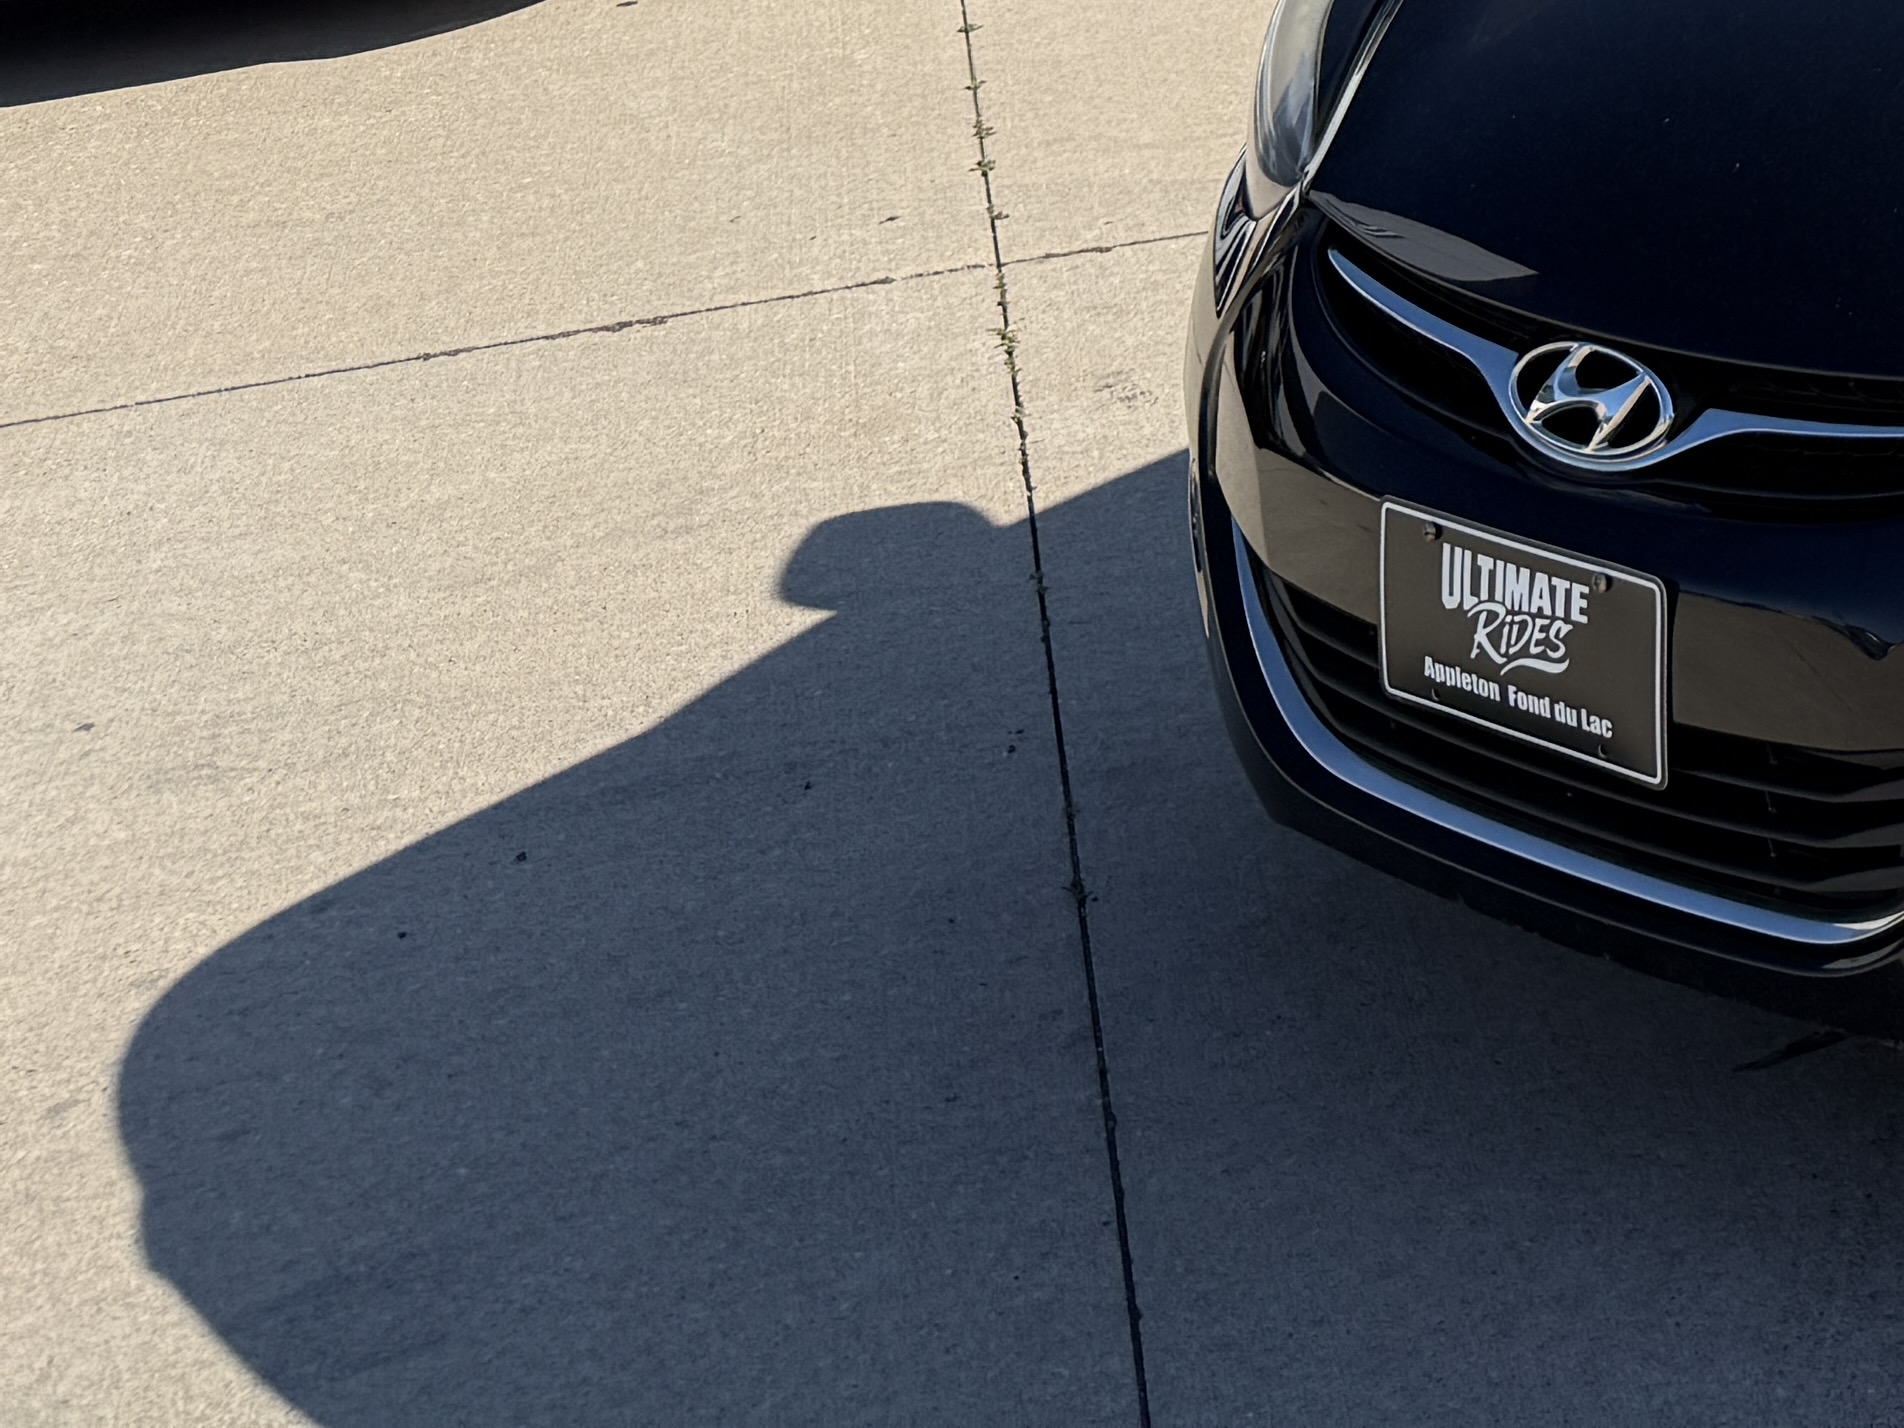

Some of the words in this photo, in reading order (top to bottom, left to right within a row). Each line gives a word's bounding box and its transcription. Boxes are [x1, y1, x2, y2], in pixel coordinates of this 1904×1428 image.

[1441, 542, 1590, 624] ULTIMATE
[1424, 655, 1500, 702] Appleton
[1507, 684, 1551, 719] Fond
[1554, 700, 1578, 728] du
[1581, 708, 1613, 739] Lac
